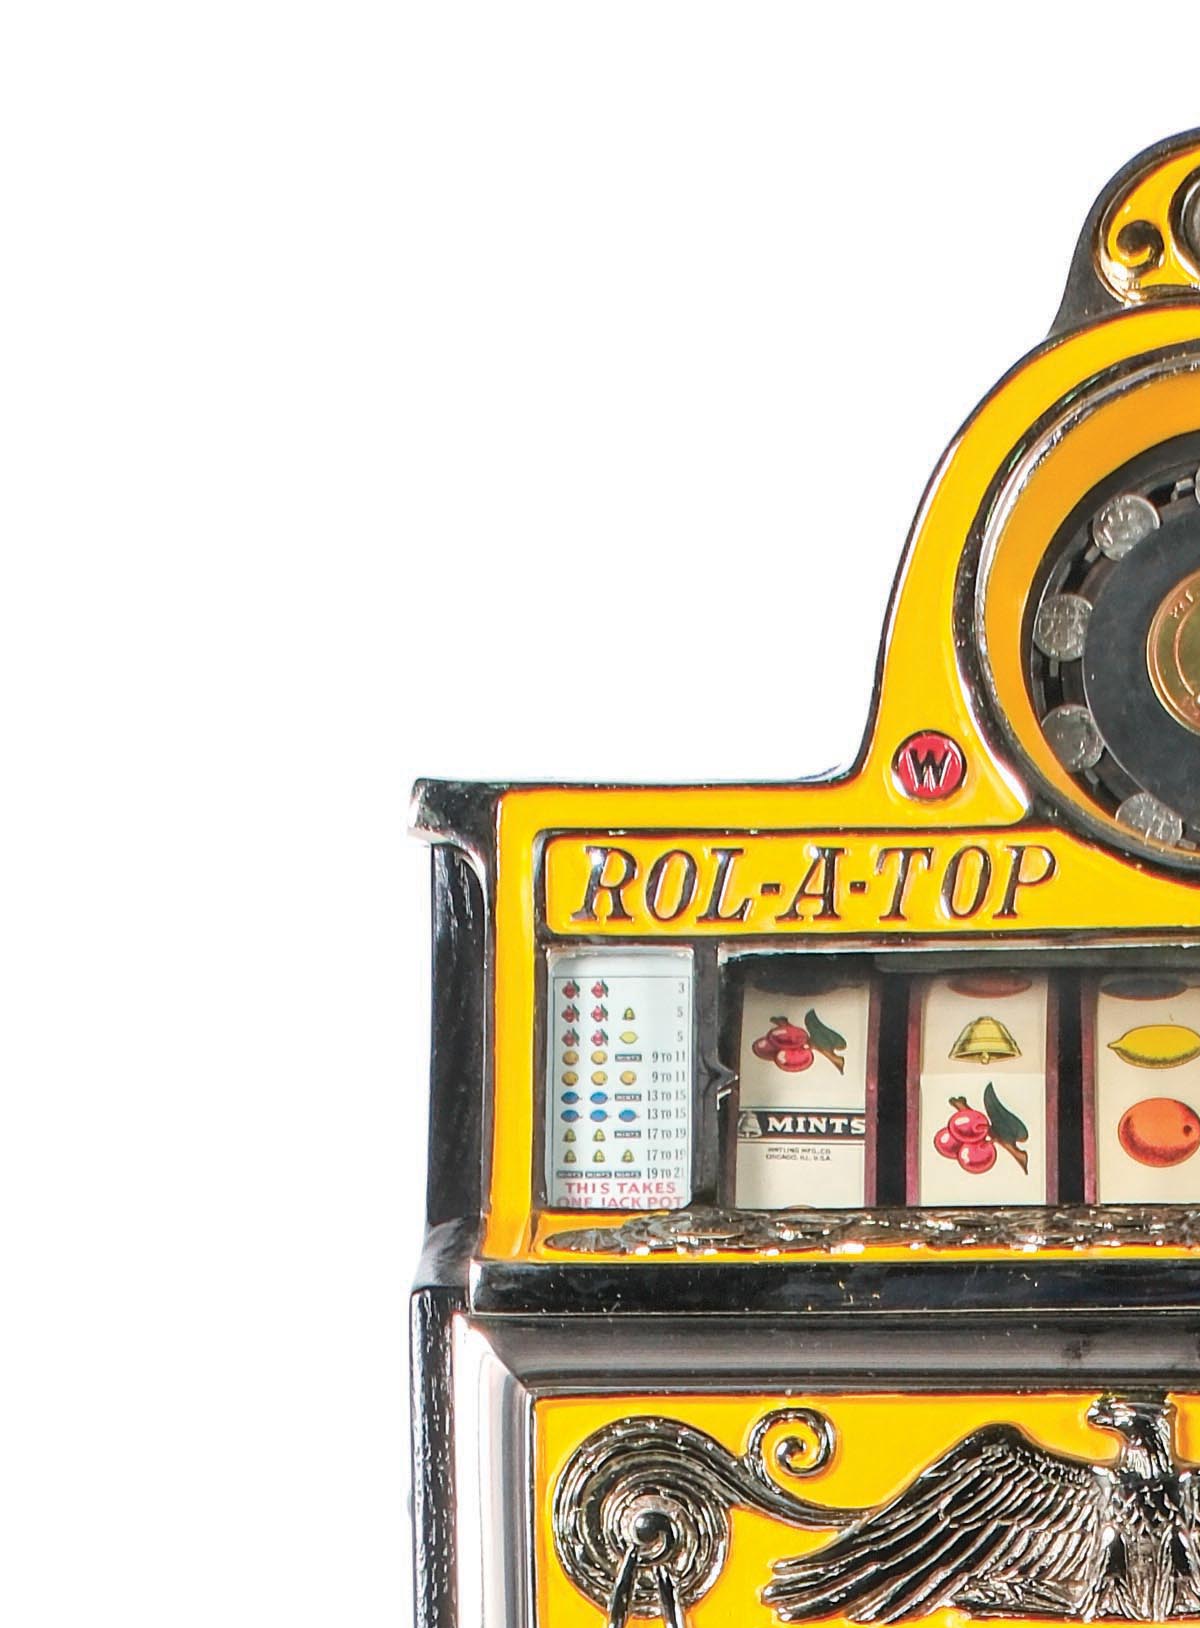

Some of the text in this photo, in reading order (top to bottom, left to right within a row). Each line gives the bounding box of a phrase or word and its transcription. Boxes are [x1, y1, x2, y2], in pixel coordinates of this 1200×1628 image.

[907, 747, 952, 792] W
[571, 844, 1057, 922] ROL-A-TOP
[678, 983, 685, 994] 3
[652, 1051, 659, 1062] 9
[652, 1072, 659, 1083] 9
[647, 1090, 658, 1101] 13
[647, 1109, 658, 1120] 13
[767, 1115, 865, 1135] MINTS
[647, 1128, 658, 1139] 17
[647, 1149, 658, 1160] 17
[647, 1168, 658, 1179] 19
[565, 1183, 676, 1194] THIS TAKES
[647, 1196, 684, 1209] POT
